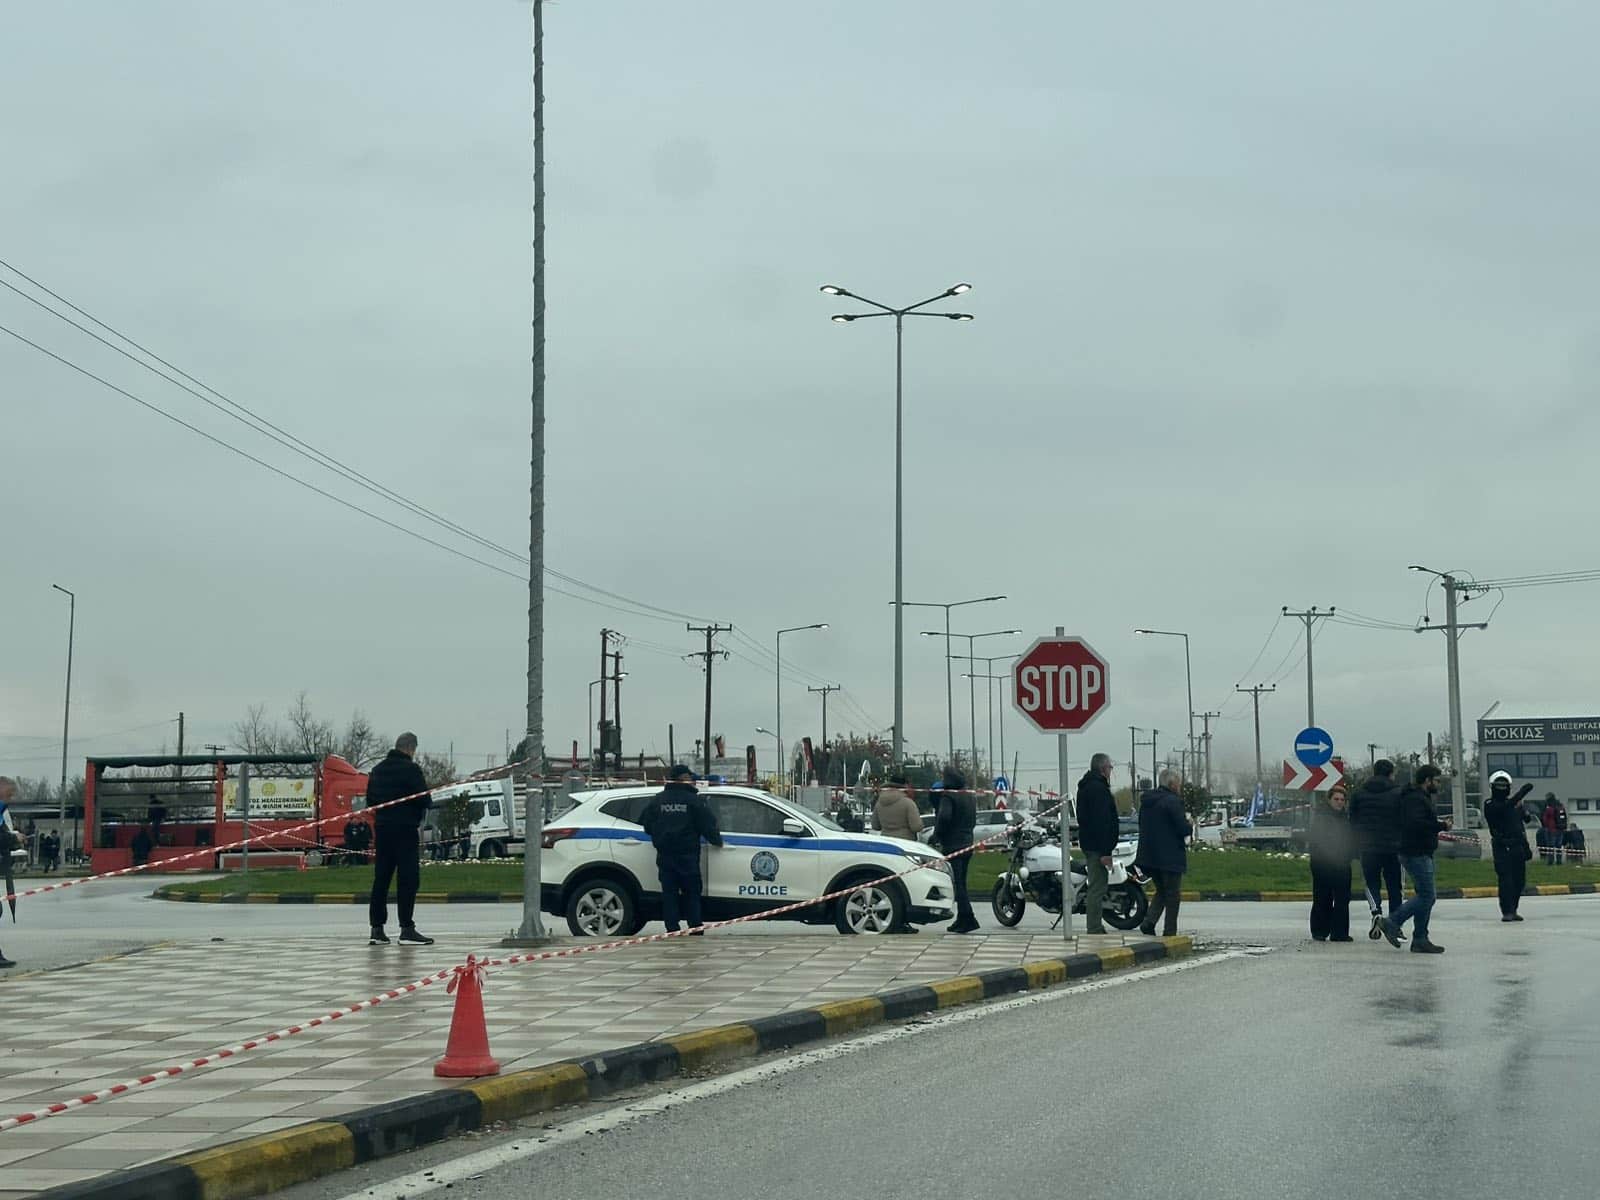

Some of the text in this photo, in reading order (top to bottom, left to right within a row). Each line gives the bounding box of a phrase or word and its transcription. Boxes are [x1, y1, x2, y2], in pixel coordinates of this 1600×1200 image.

[1021, 664, 1101, 712] STOP
[1484, 727, 1545, 739] ΜΟΚΙΑΣ
[660, 804, 687, 812] POLICE
[739, 885, 787, 895] POLICE
